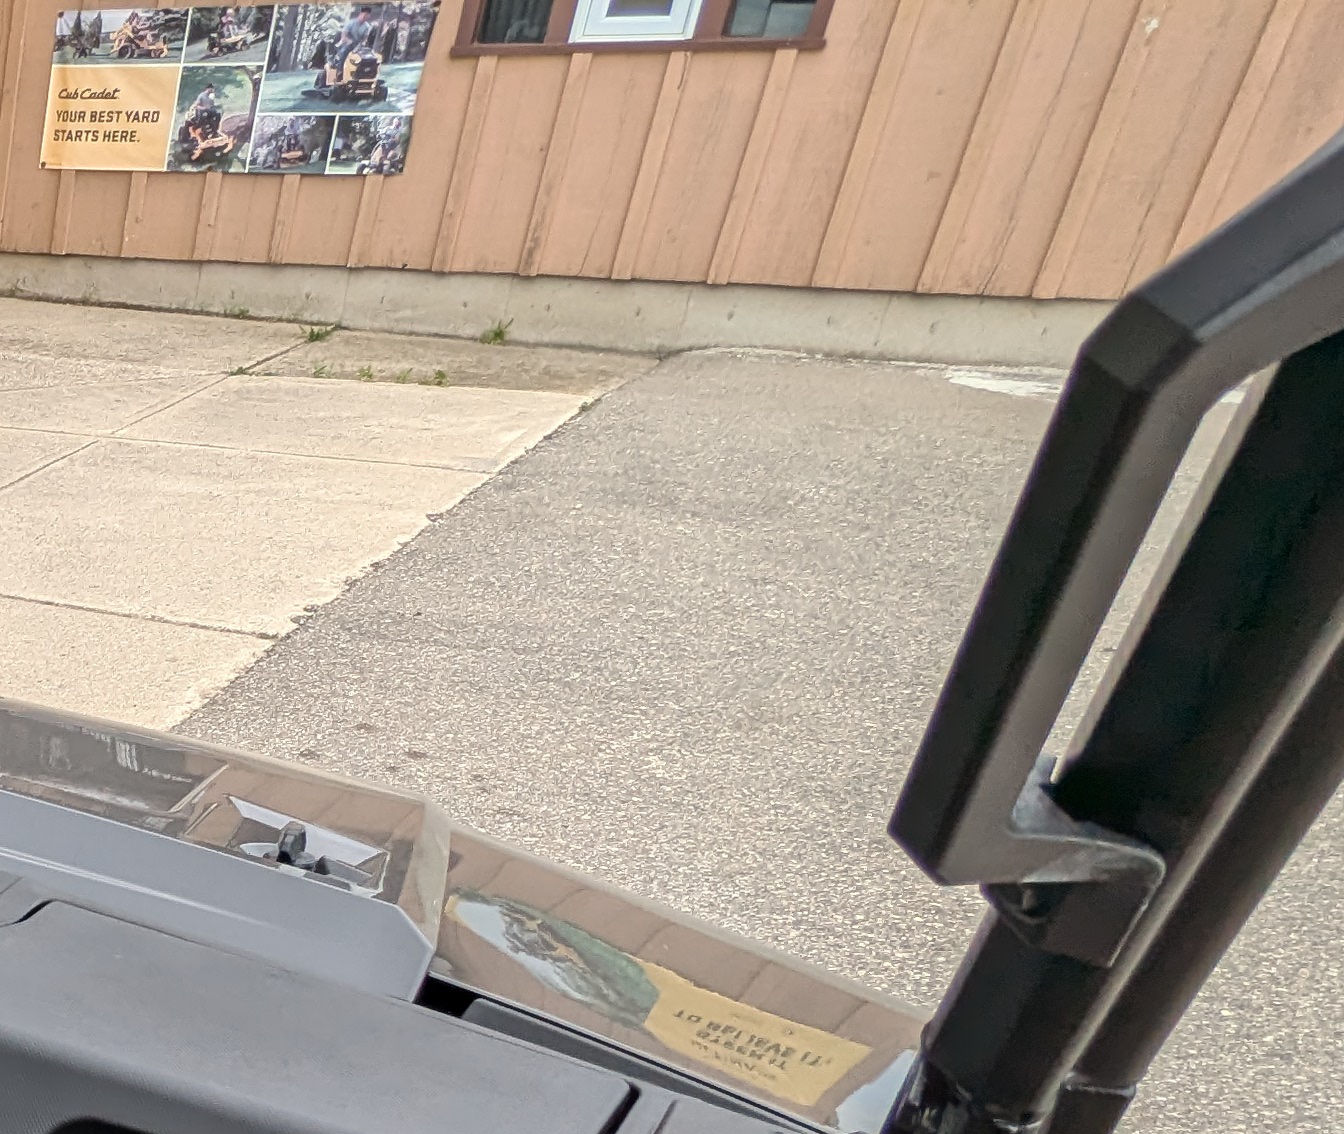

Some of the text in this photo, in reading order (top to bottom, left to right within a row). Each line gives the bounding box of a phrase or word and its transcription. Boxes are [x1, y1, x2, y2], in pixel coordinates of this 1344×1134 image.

[58, 88, 121, 99] Cub Cadet
[56, 110, 161, 123] YOUR BEST YARD
[53, 129, 141, 143] STARTS HERE.
